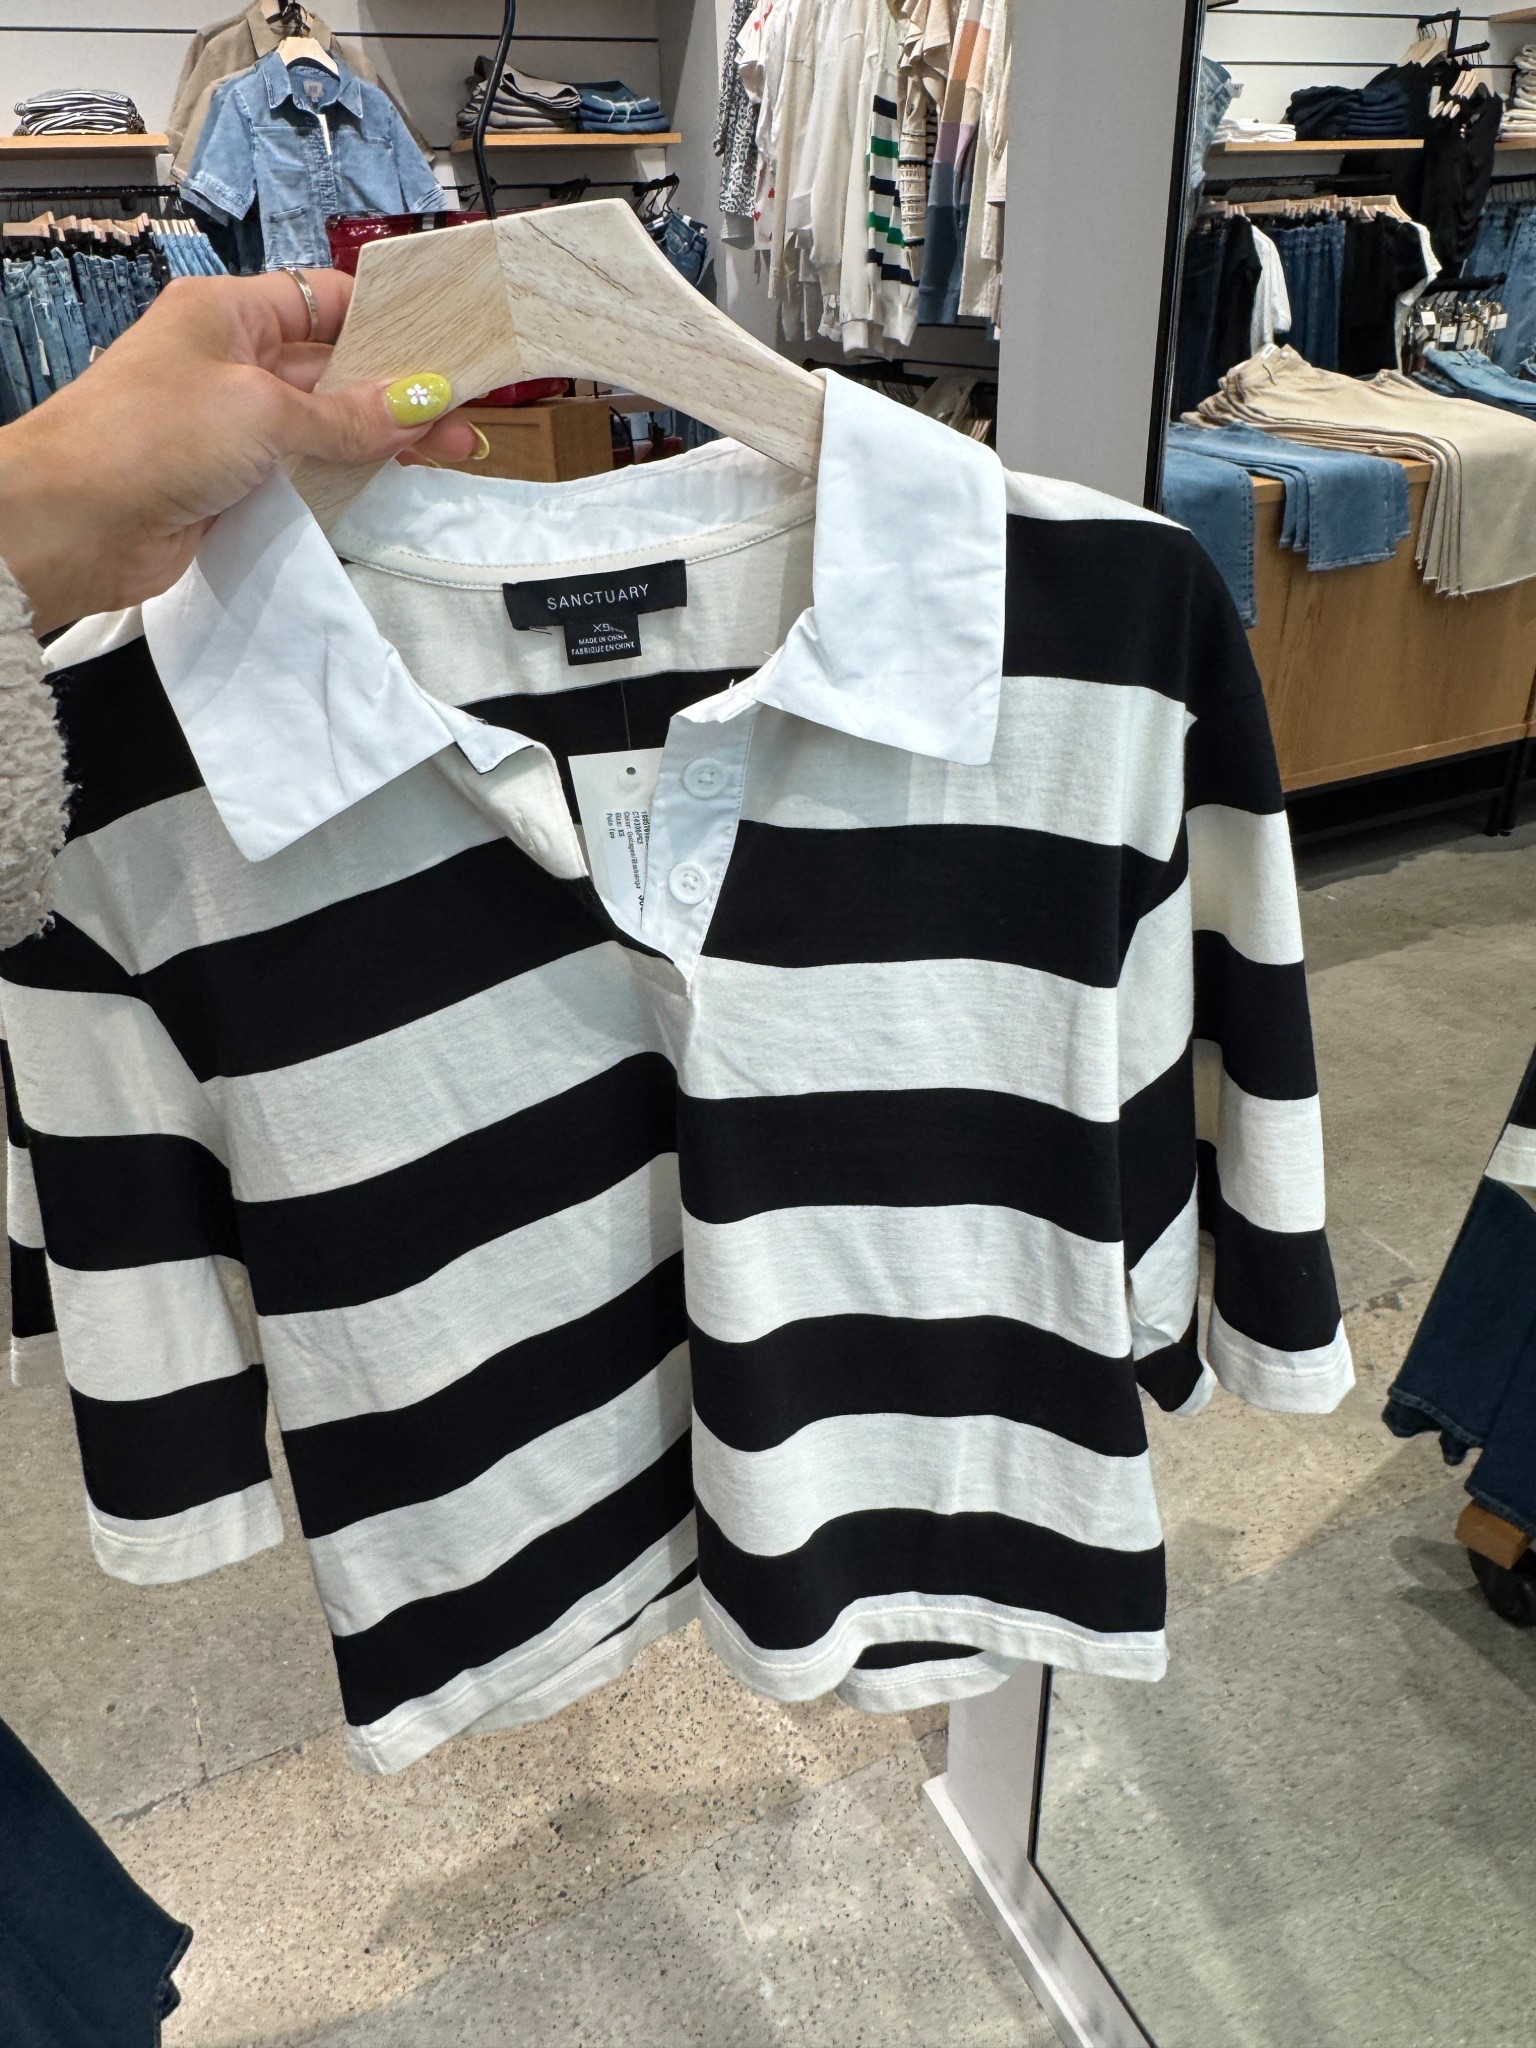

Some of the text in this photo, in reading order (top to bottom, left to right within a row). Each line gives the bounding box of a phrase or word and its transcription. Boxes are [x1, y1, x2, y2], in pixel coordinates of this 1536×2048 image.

[547, 583, 649, 610] SANCTUARY
[598, 636, 607, 644] IN
[607, 633, 628, 642] CHINA
[615, 641, 635, 650] CHINE
